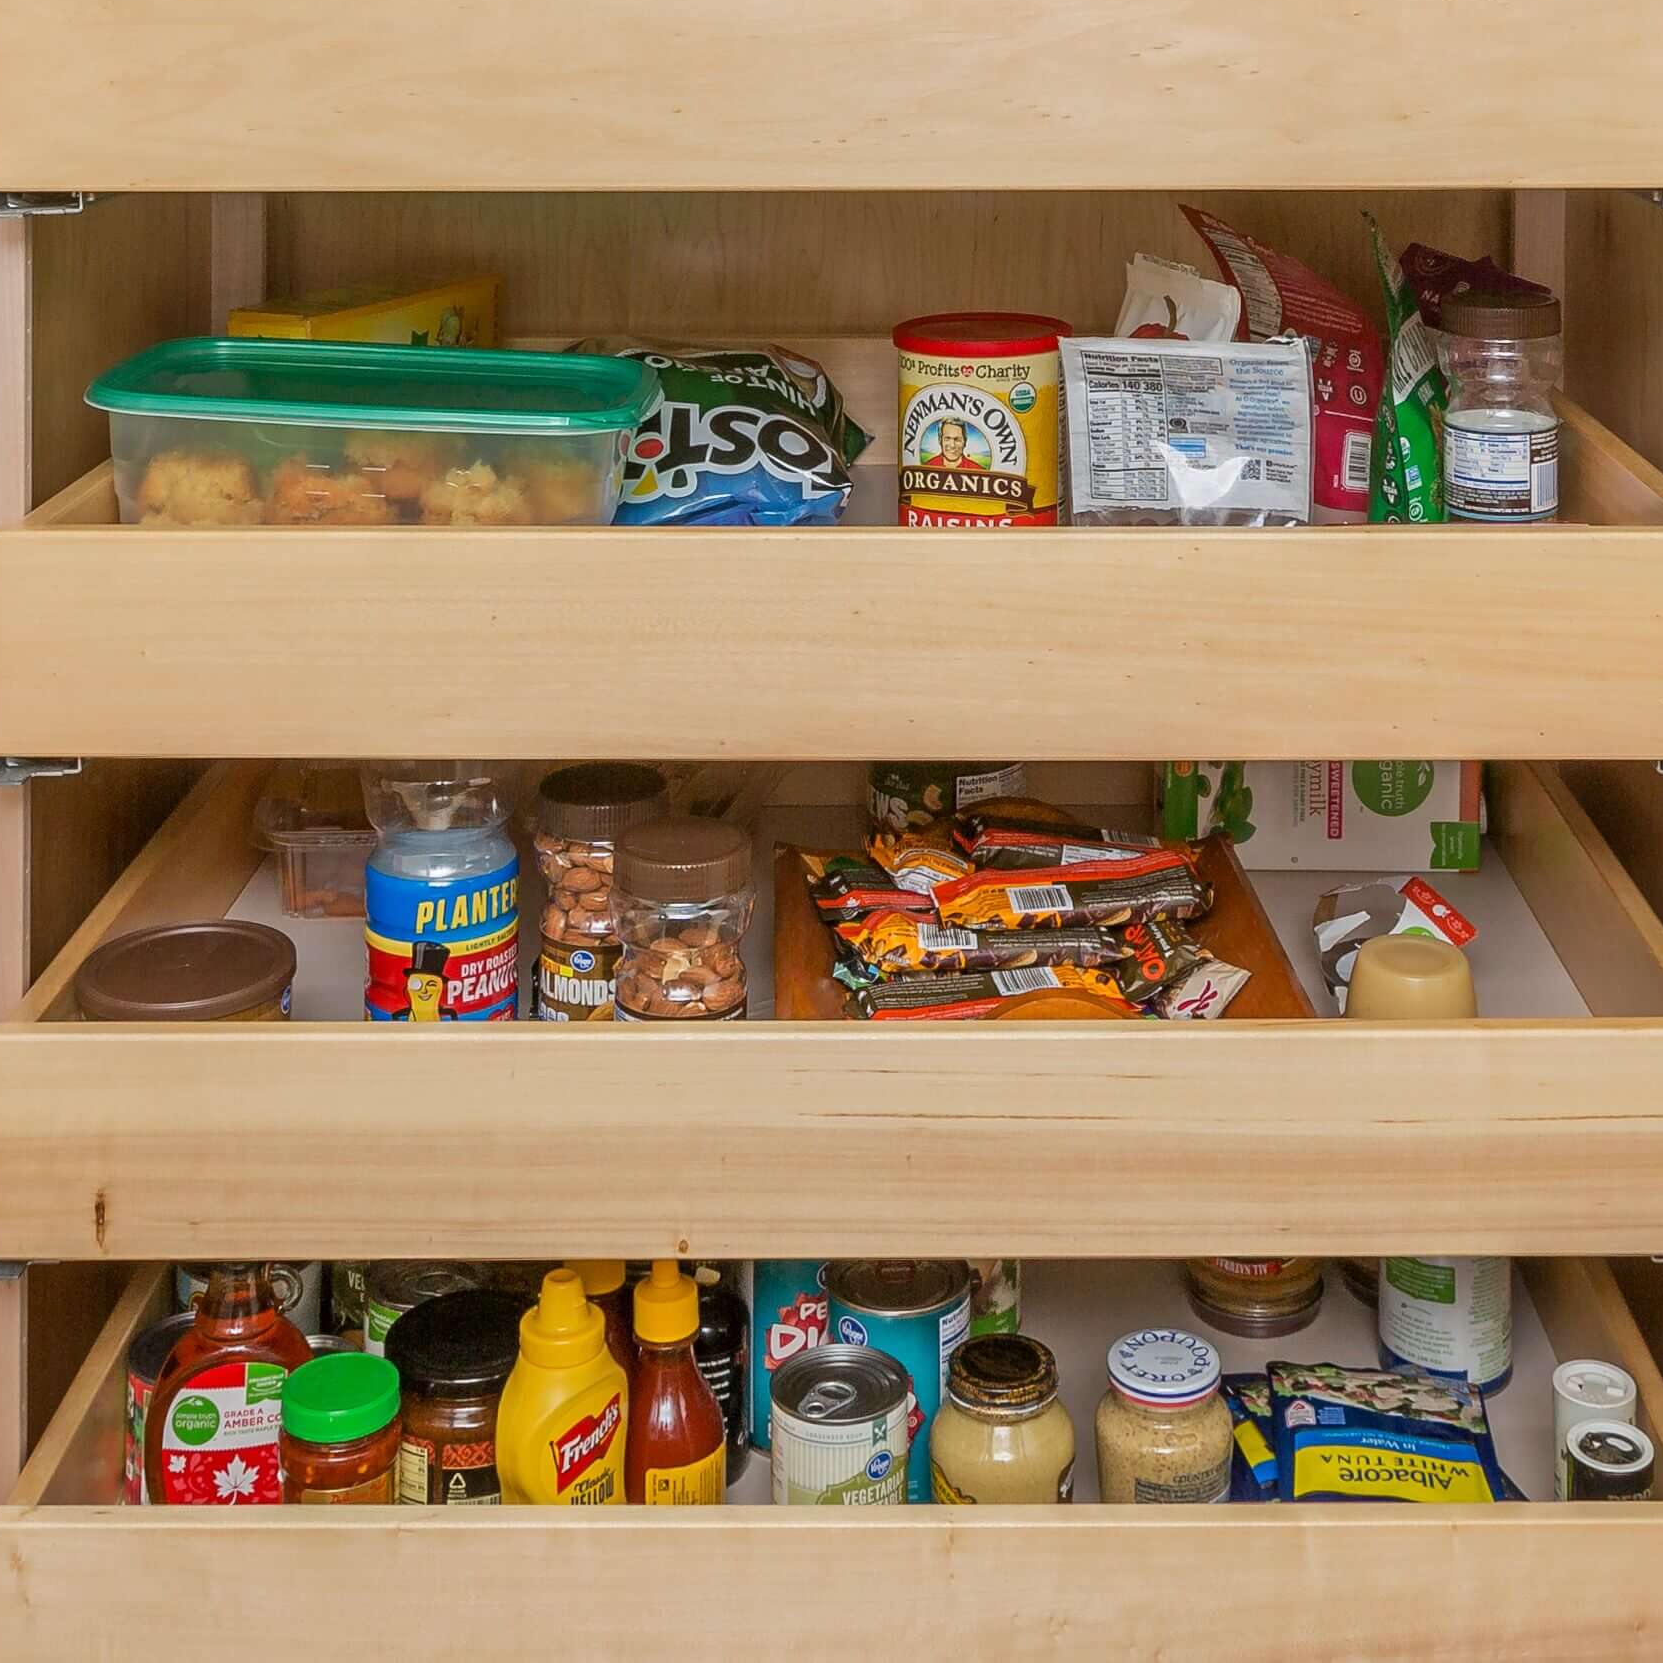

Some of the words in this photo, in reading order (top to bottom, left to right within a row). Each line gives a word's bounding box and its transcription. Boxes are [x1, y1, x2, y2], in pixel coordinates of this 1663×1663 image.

[1084, 353, 1128, 363] Nutrition
[1131, 355, 1159, 363] Facts
[918, 360, 960, 377] Profits
[976, 364, 1031, 381] Charity
[710, 373, 742, 385] OF
[1088, 380, 1120, 389] Calories
[1122, 380, 1140, 391] 140
[1143, 382, 1163, 392] 380
[904, 391, 985, 457] NEWMAN'S
[983, 408, 1018, 466] OWN
[903, 470, 1023, 497] ORGANICS
[959, 775, 997, 786] Nutrition
[959, 786, 983, 795] Facts
[1329, 762, 1340, 837] SWEETENED
[465, 938, 495, 952] LIGHTLY
[460, 960, 484, 978] DRY
[224, 1409, 257, 1418] GRADE
[175, 1418, 217, 1432] organic
[224, 1416, 263, 1429] AMBER
[560, 1404, 619, 1474] French's
[1360, 1436, 1401, 1450] Water
[1405, 1442, 1416, 1453] In
[868, 1457, 890, 1477] Kroger
[1320, 1453, 1387, 1467] TUNA
[1393, 1456, 1469, 1478] WHITE
[1339, 1466, 1453, 1490] Albacore
